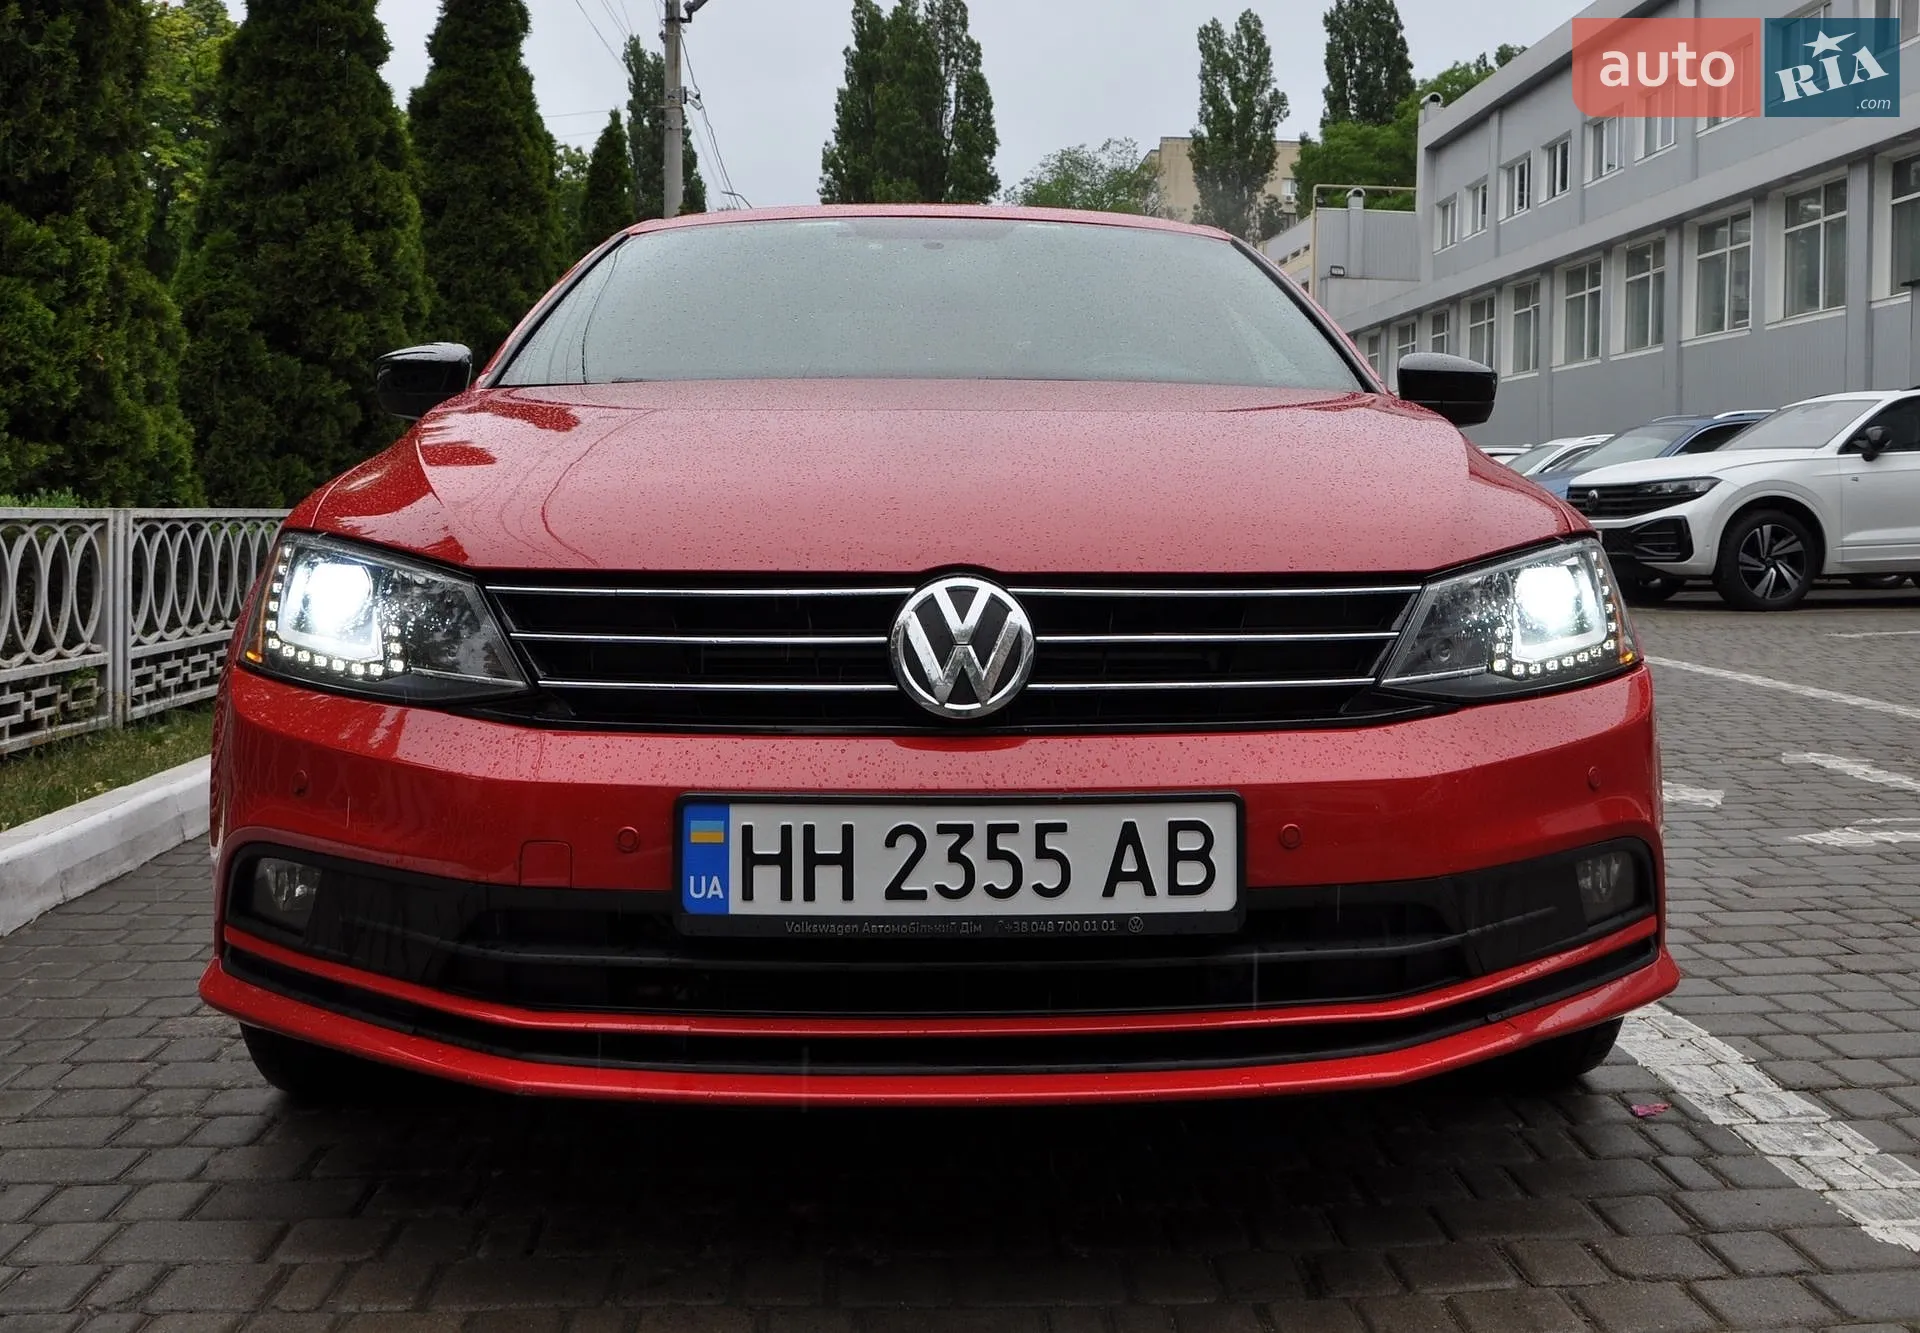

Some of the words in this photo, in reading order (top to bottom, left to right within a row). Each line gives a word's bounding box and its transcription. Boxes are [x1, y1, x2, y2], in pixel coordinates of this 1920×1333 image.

[741, 823, 854, 901] HH
[884, 822, 1071, 900] 2355
[1102, 819, 1216, 897] AB
[689, 876, 723, 898] UA
[785, 921, 858, 935] Volkswagen
[960, 920, 982, 934] Дім
[1031, 920, 1054, 933] 048
[1057, 920, 1081, 933] 700
[1083, 920, 1098, 933] 01
[1101, 919, 1116, 931] 01
